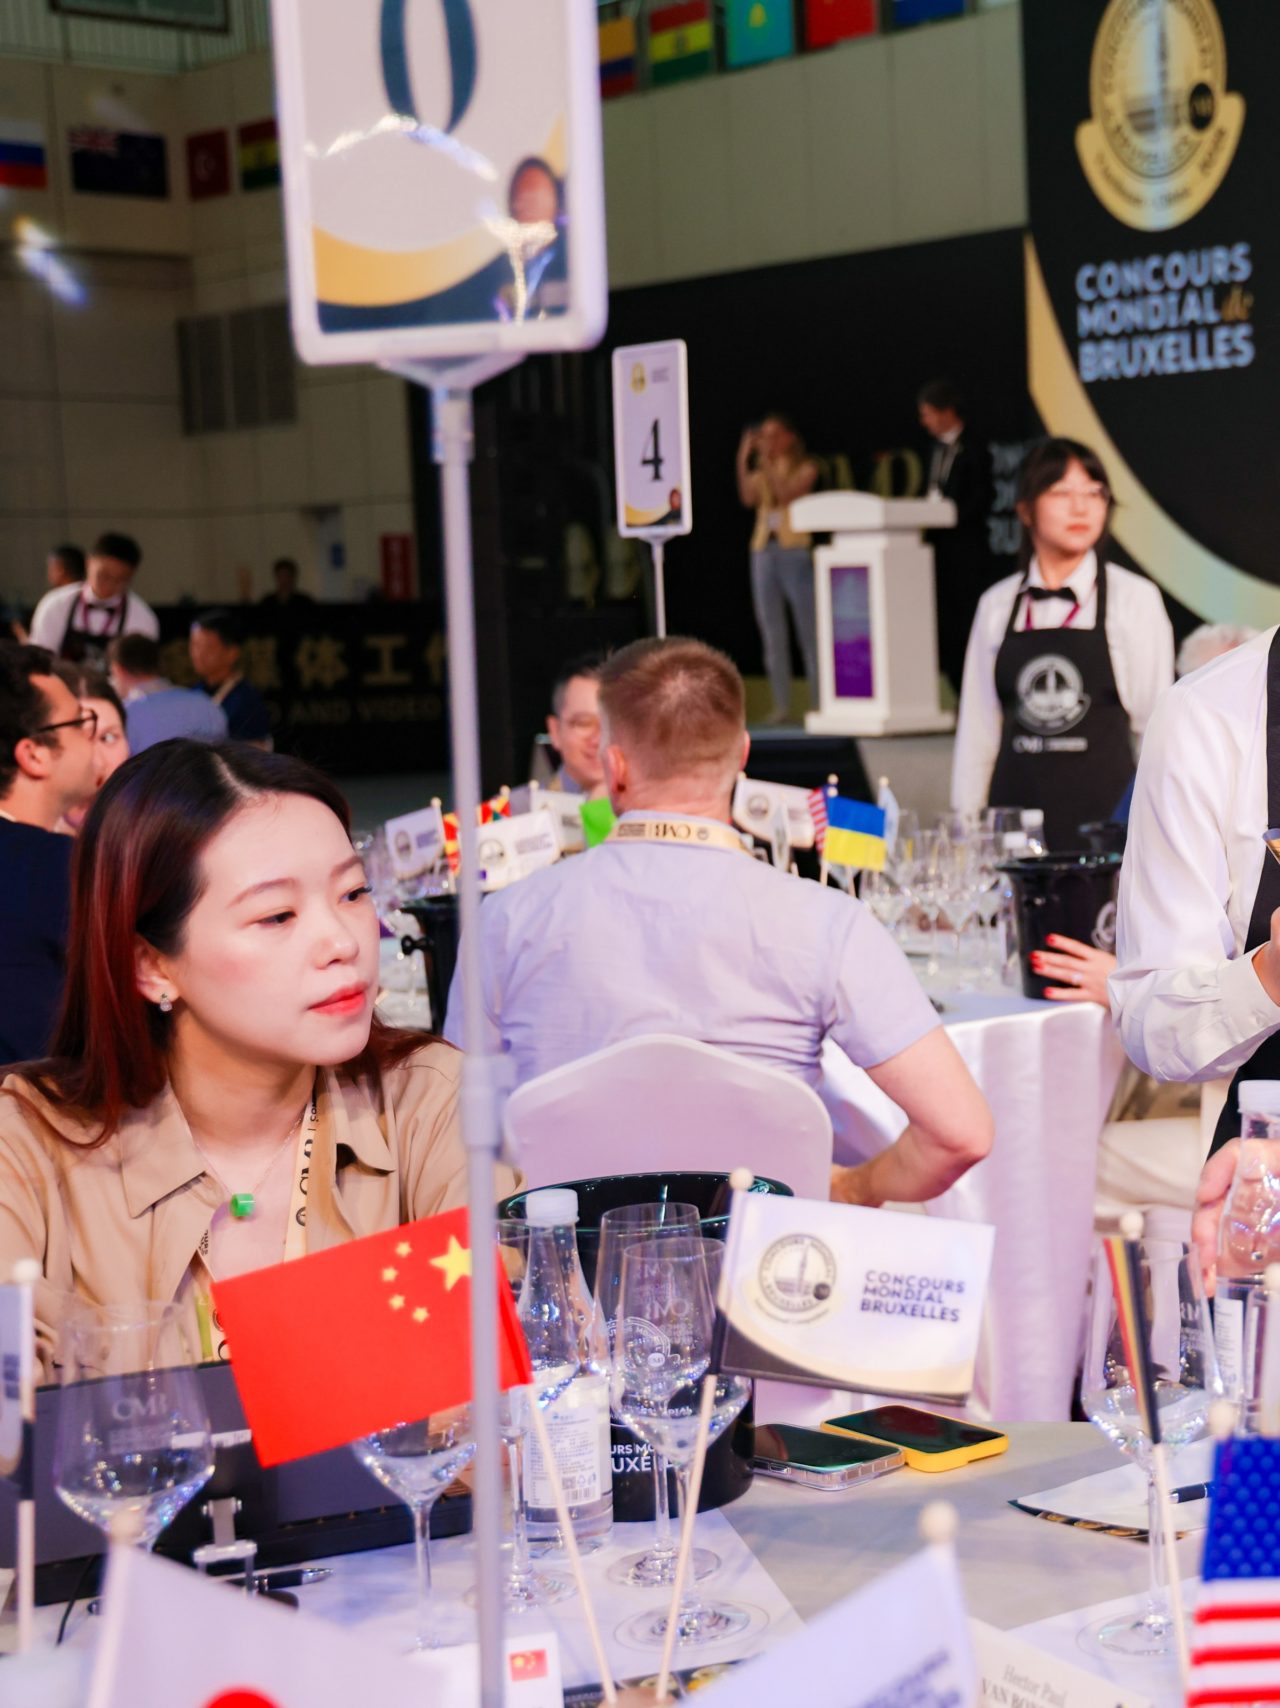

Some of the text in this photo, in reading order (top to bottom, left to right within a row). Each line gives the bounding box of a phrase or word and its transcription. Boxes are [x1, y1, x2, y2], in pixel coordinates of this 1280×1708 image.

[1075, 242, 1253, 301] CONCOURS
[1077, 287, 1221, 338] MONDIAL
[1078, 323, 1255, 383] BRUXELLES
[640, 417, 664, 482] 4
[863, 1284, 944, 1304] MONDIAL
[865, 1269, 965, 1294] CONCOURS
[860, 1297, 959, 1322] BRUXELLES
